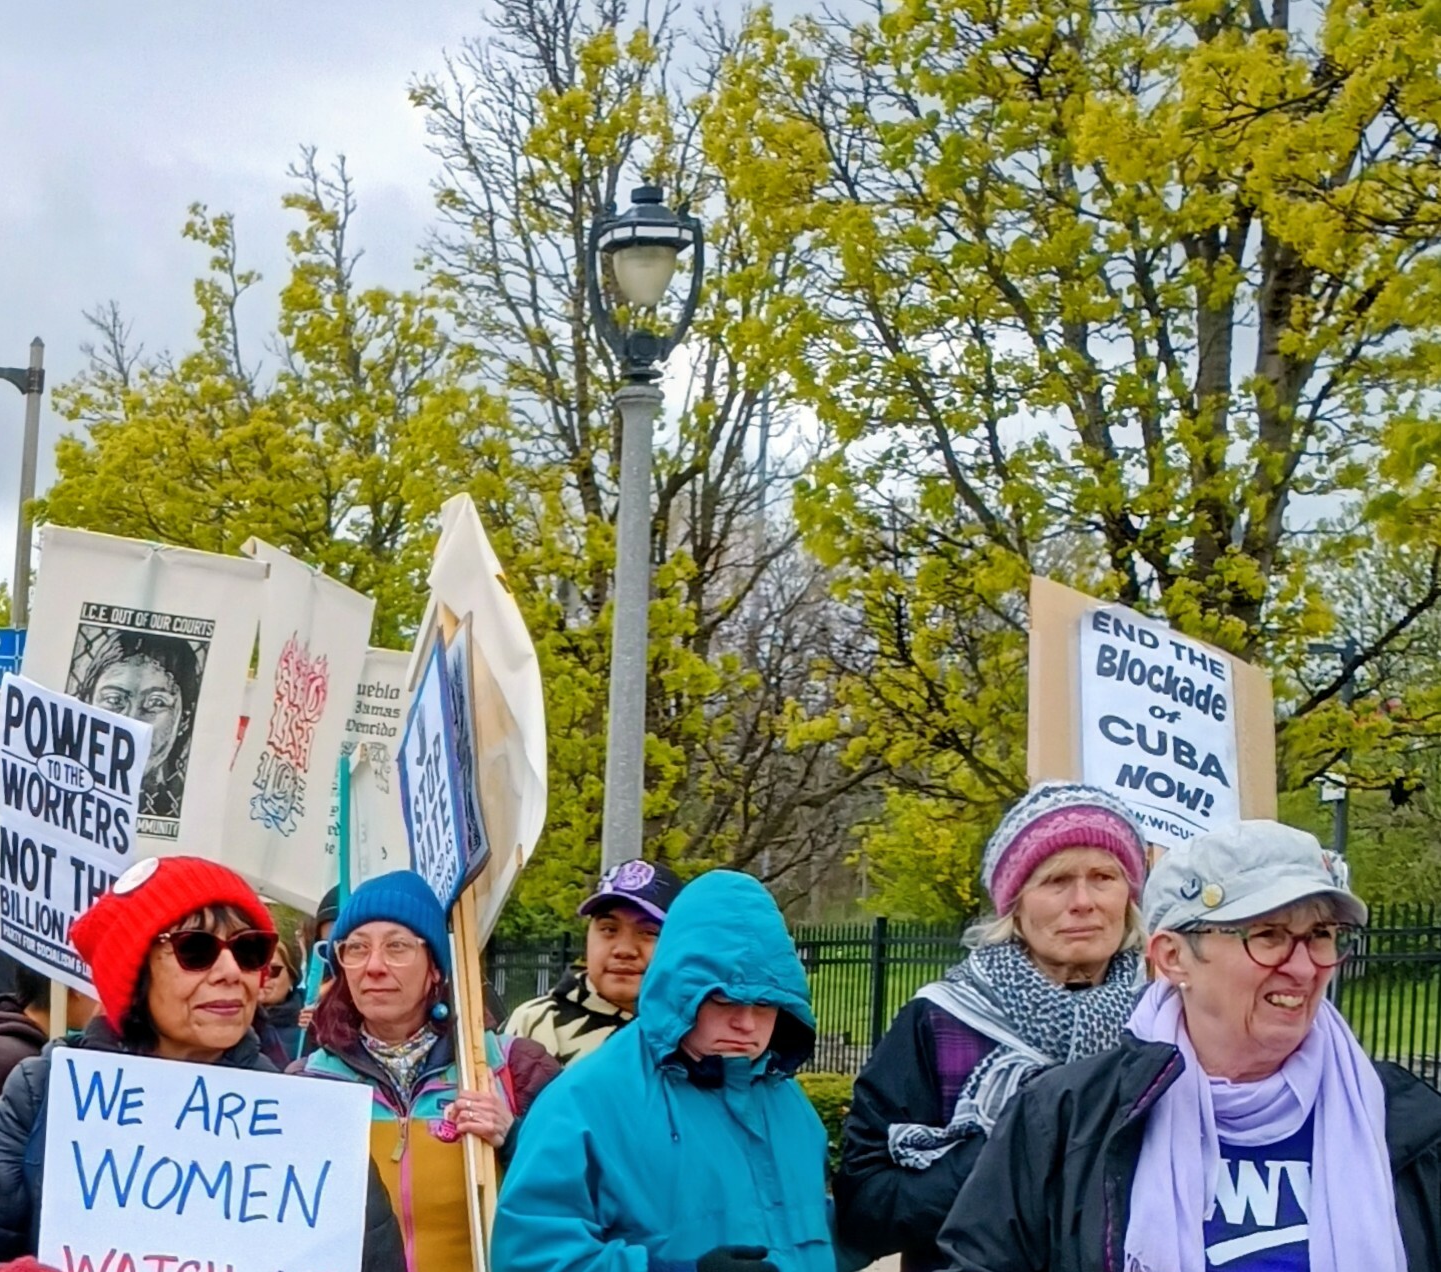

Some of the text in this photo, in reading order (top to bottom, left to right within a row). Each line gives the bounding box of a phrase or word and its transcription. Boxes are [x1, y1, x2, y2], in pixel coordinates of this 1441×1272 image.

[111, 608, 135, 624] OUT
[135, 611, 150, 627] OF
[150, 614, 171, 631] OUR
[173, 616, 214, 636] COURTS
[1092, 611, 1226, 682] END THE
[1096, 643, 1227, 722] Blockade
[1149, 705, 1182, 723] of
[3, 684, 136, 796] POWER
[47, 758, 85, 788] TO THE
[1098, 714, 1231, 788] CUBA
[1, 758, 129, 855] WORKERS
[1115, 763, 1215, 818] NOW!
[0, 825, 57, 899] NOT
[3, 923, 22, 945] PARTY
[22, 934, 36, 952] FOR
[37, 941, 75, 970] SOCIALISM
[67, 1058, 283, 1140] WE ARE
[71, 1141, 332, 1228] WOMEN
